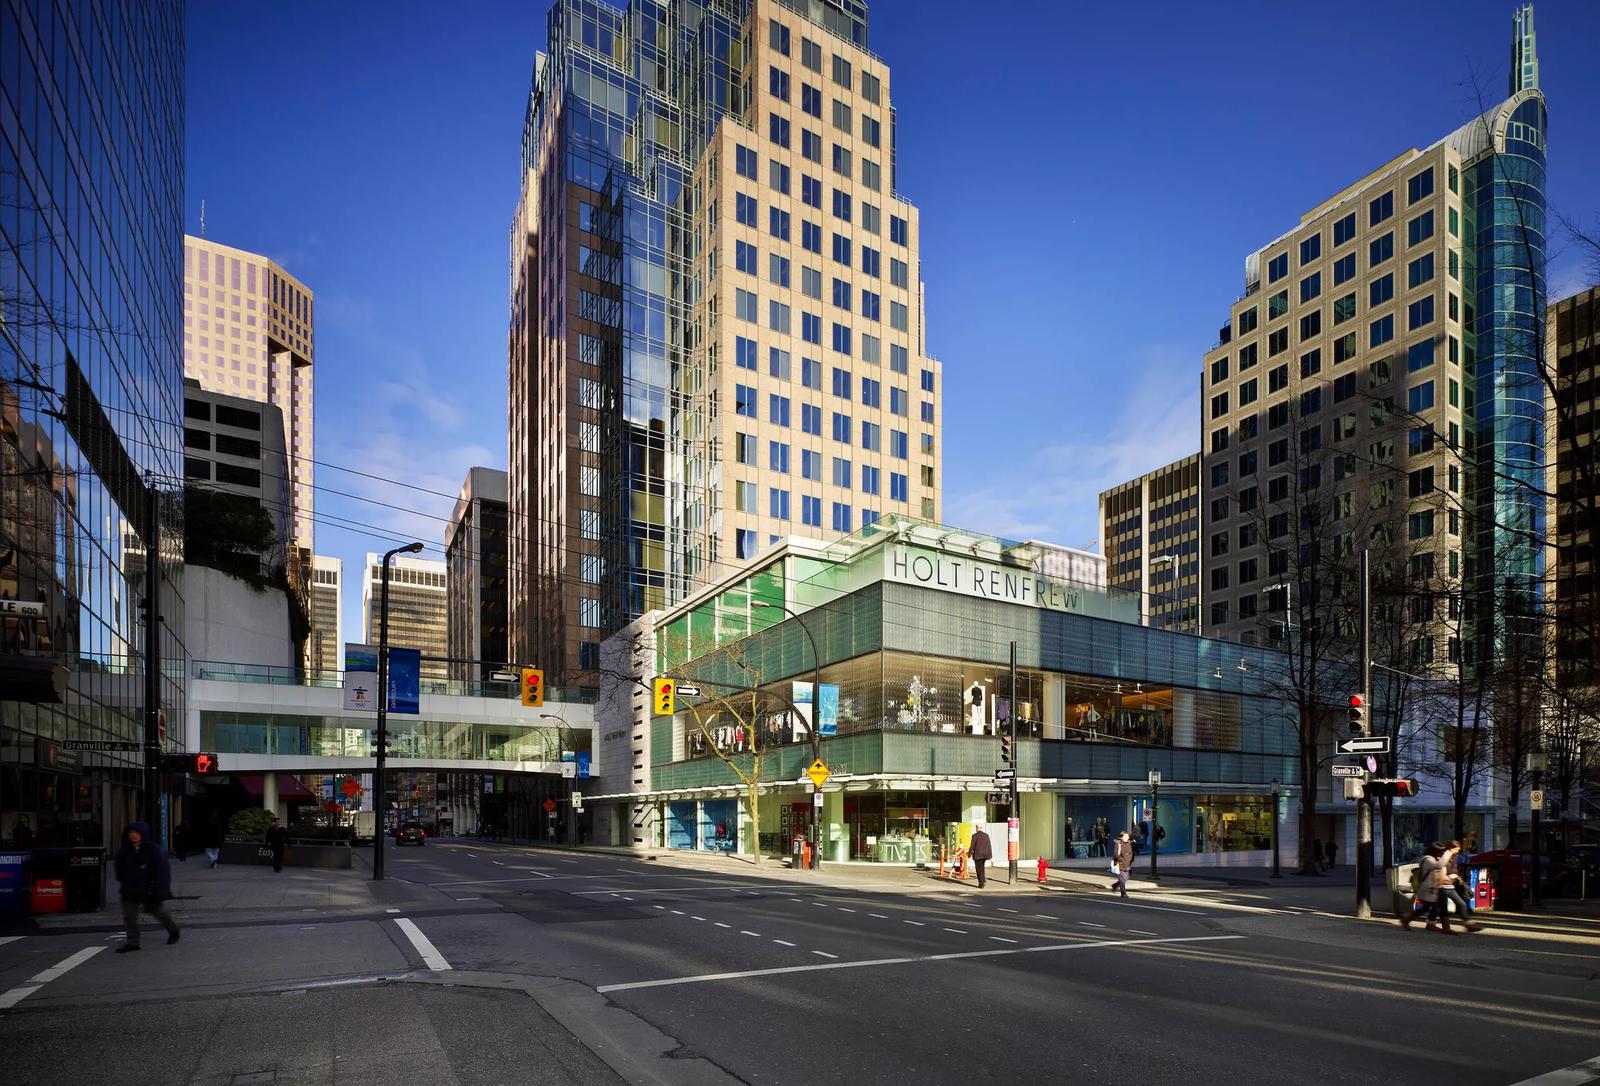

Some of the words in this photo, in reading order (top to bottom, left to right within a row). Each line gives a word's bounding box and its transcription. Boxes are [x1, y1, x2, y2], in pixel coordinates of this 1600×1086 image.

[894, 552, 961, 588] HOLT
[974, 566, 1078, 609] RENFREW
[65, 740, 111, 751] Granville
